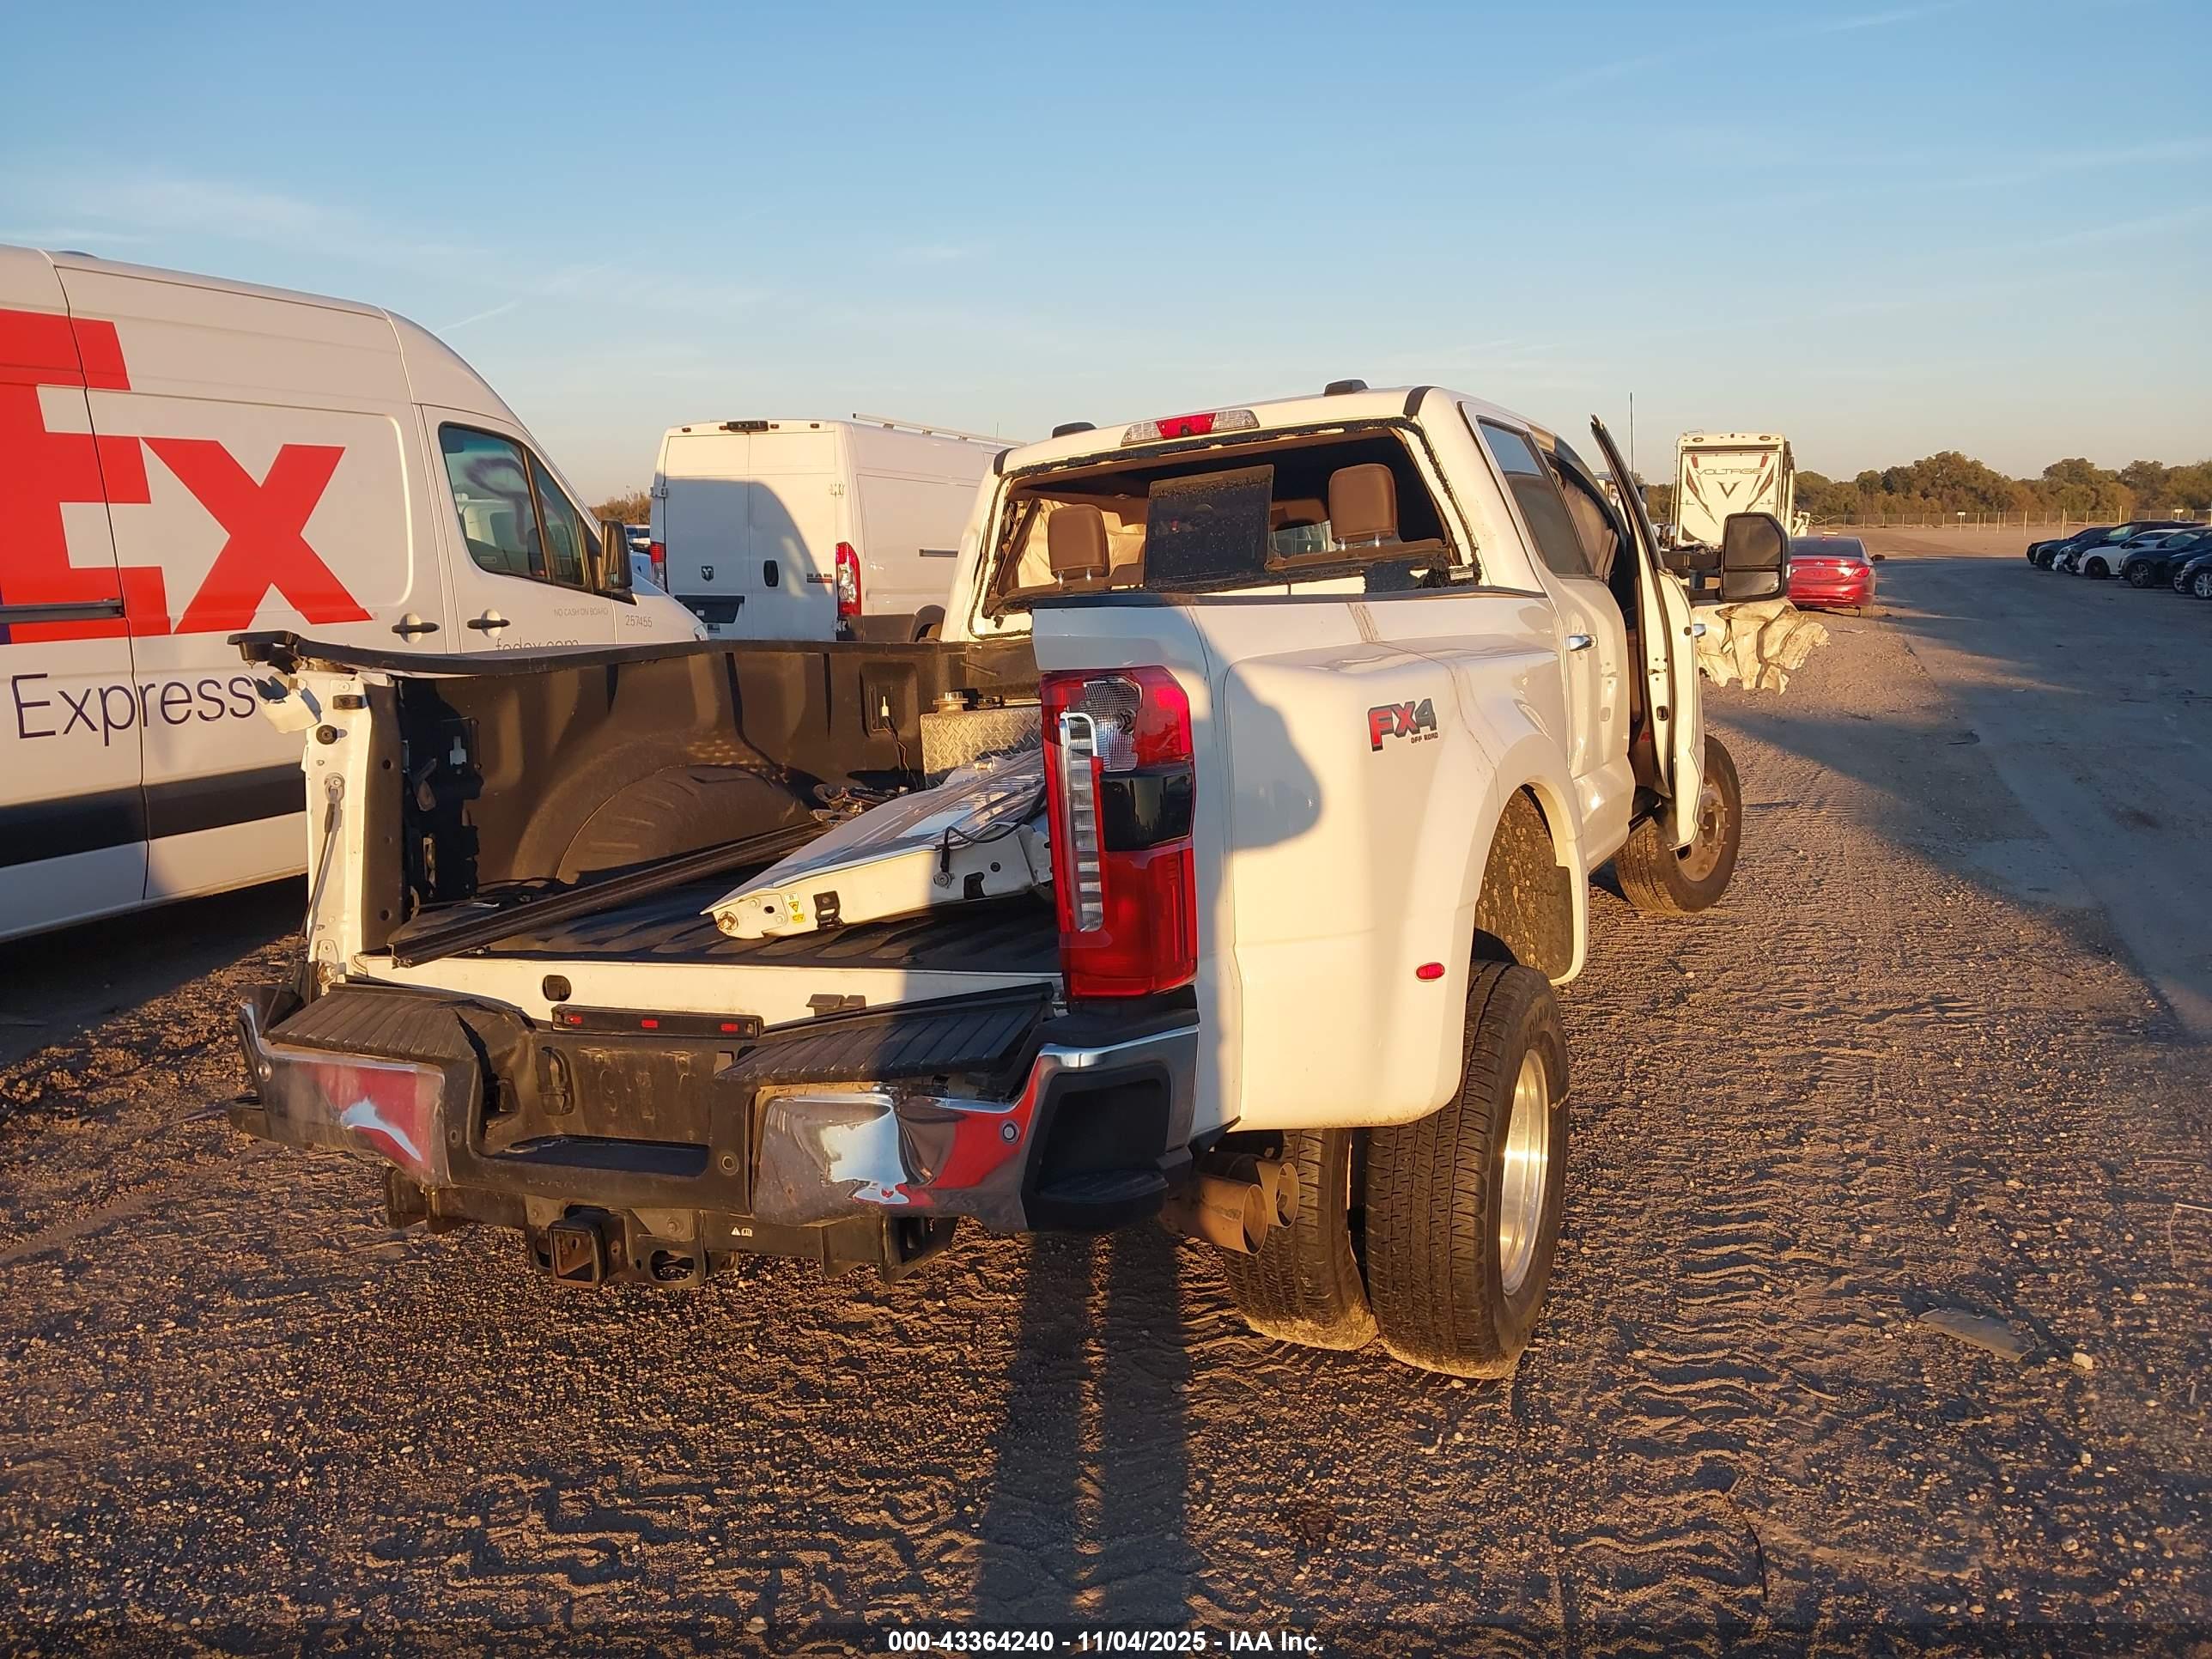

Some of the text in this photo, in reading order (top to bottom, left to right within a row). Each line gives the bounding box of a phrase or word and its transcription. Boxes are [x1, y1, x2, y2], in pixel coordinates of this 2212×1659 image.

[0, 308, 373, 644] Ex
[554, 608, 563, 617] NO
[564, 608, 579, 617] CASH
[11, 673, 256, 746] Express
[1368, 697, 1437, 751] FX4
